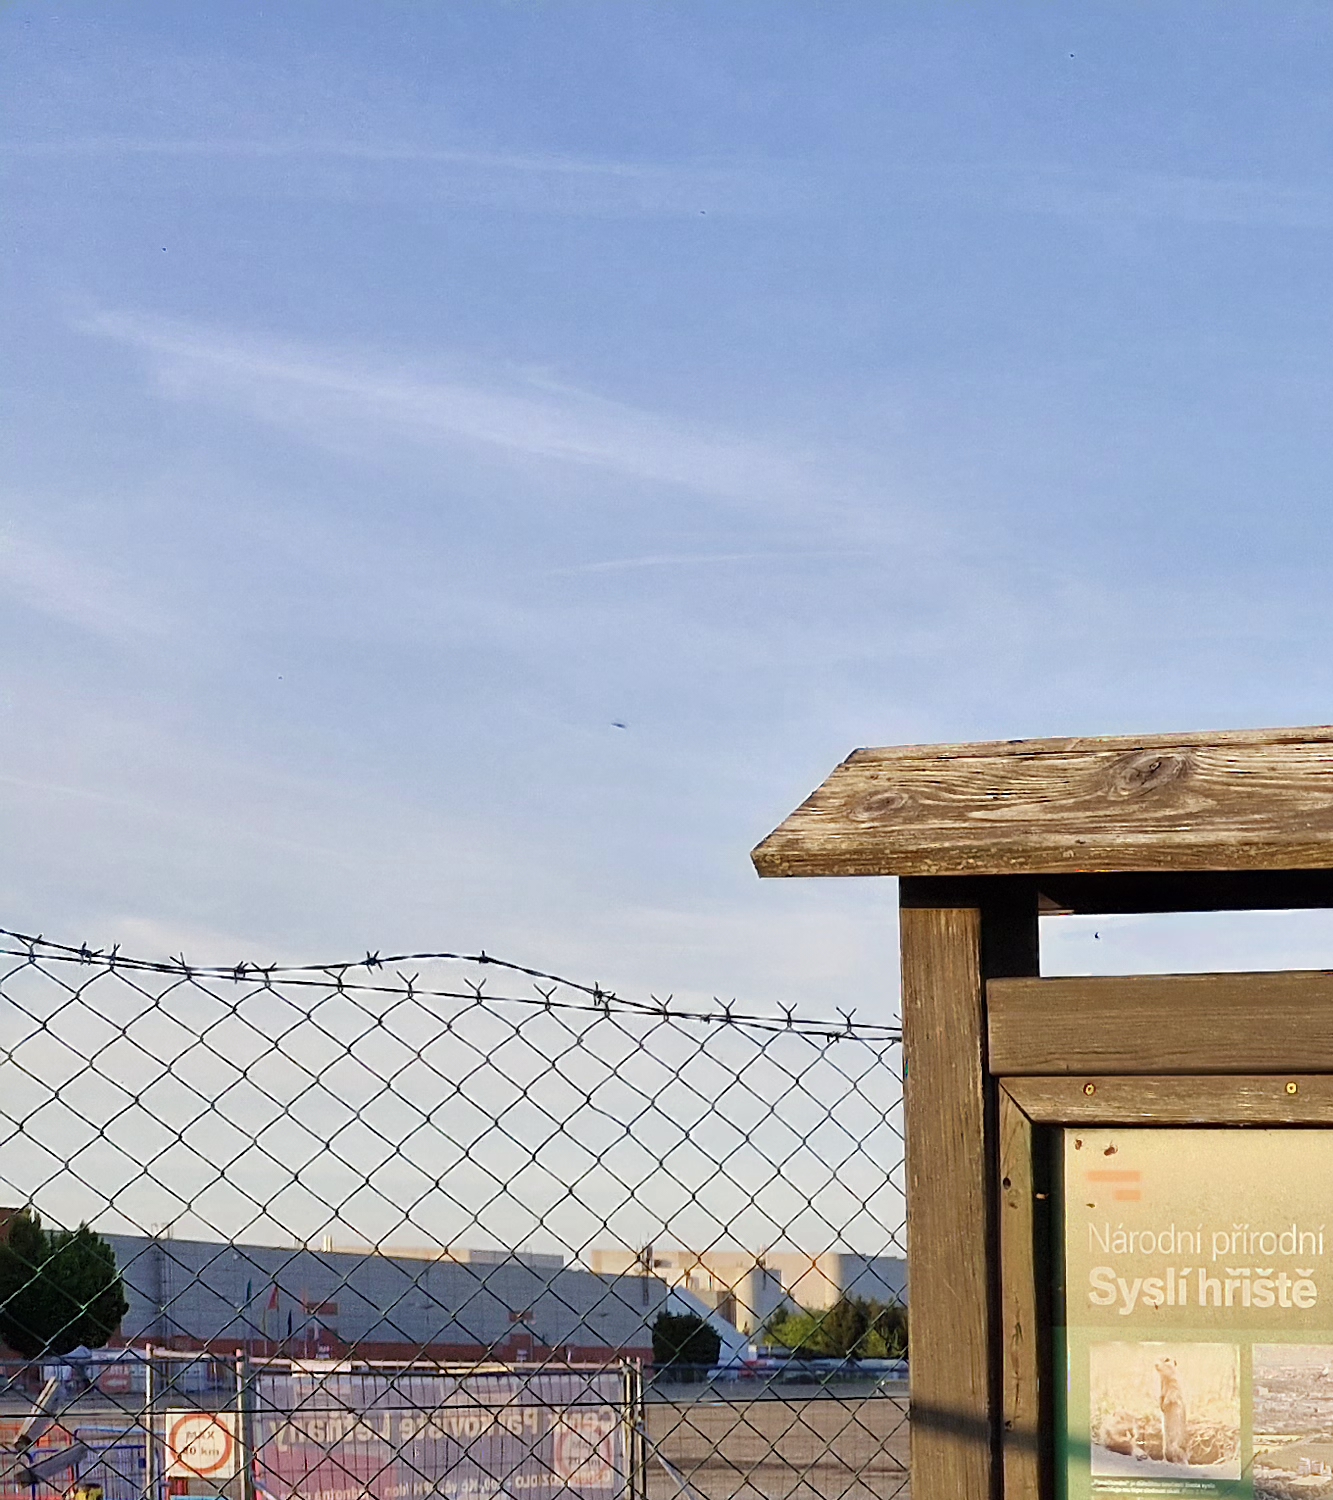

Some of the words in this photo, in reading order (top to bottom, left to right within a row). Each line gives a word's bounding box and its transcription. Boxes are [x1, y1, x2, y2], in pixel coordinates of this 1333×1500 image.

[1088, 1222, 1202, 1256] Národní
[1212, 1222, 1326, 1261] přírodní
[1088, 1266, 1187, 1314] Syslí
[1199, 1267, 1317, 1308] hřiště
[201, 1447, 219, 1455] km
